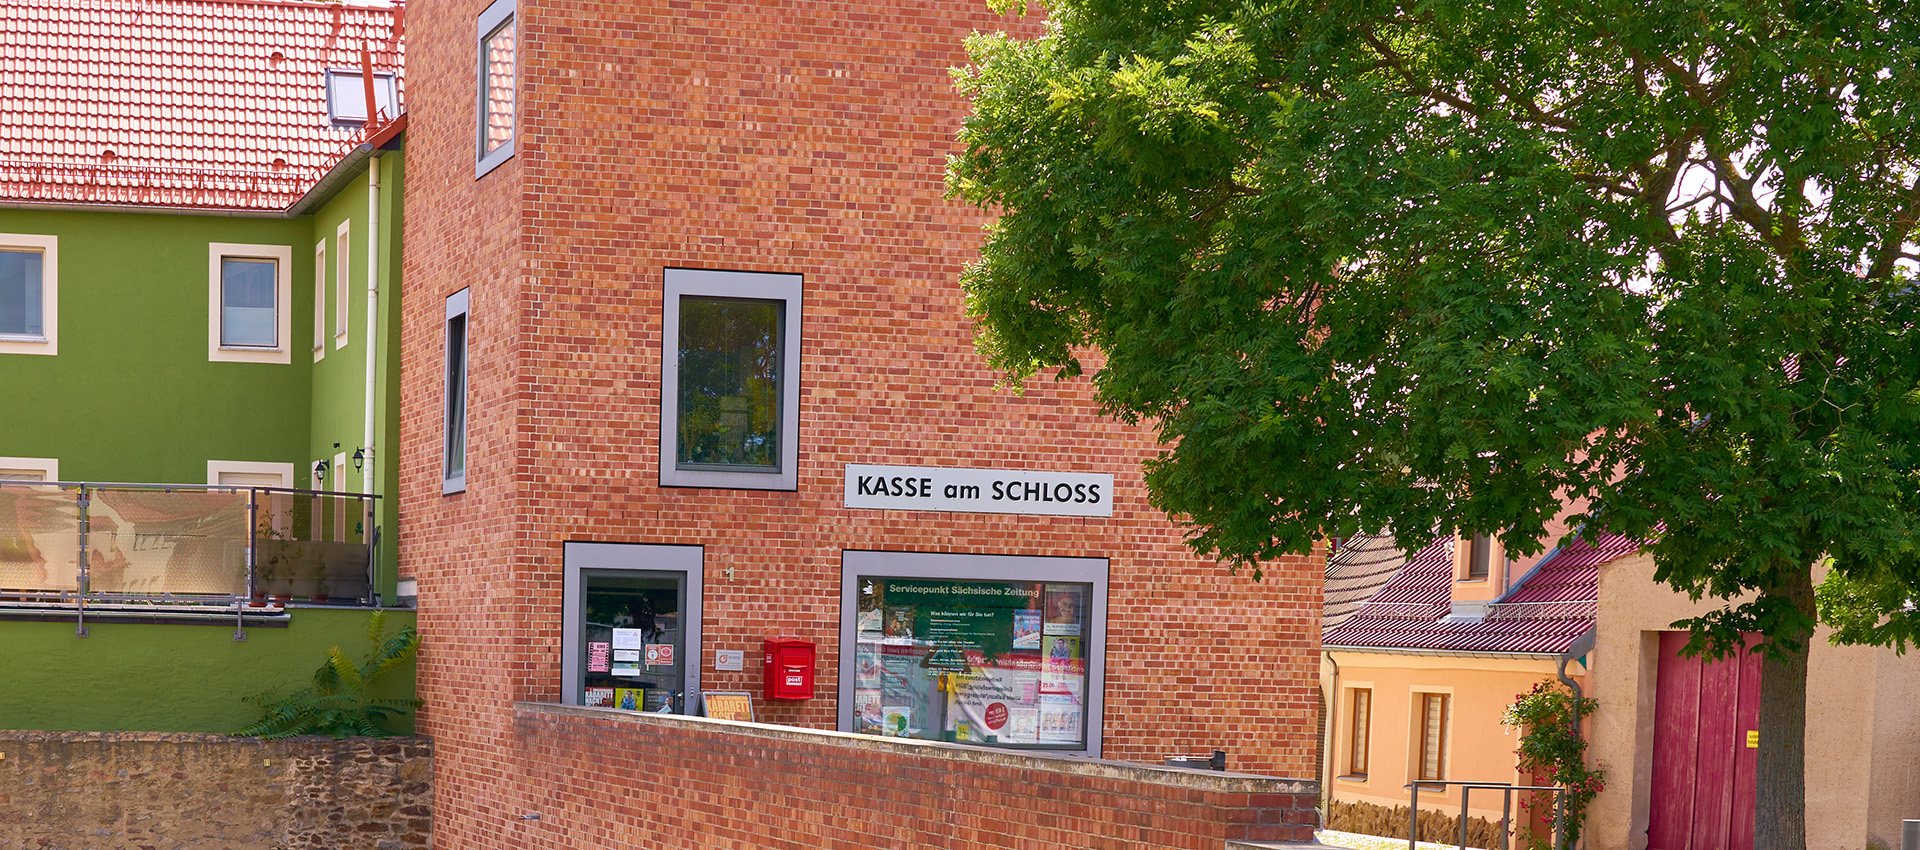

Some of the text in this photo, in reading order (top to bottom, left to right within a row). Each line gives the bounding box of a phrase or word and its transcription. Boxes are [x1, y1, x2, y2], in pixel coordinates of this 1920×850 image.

[858, 476, 1101, 504] KASSE am SCHLOSS
[726, 566, 735, 582] 1
[890, 584, 950, 594] Servicepunkt
[952, 586, 1002, 596] Sächsische
[1004, 588, 1040, 598] Zeitung
[706, 700, 750, 712] KABARETT
